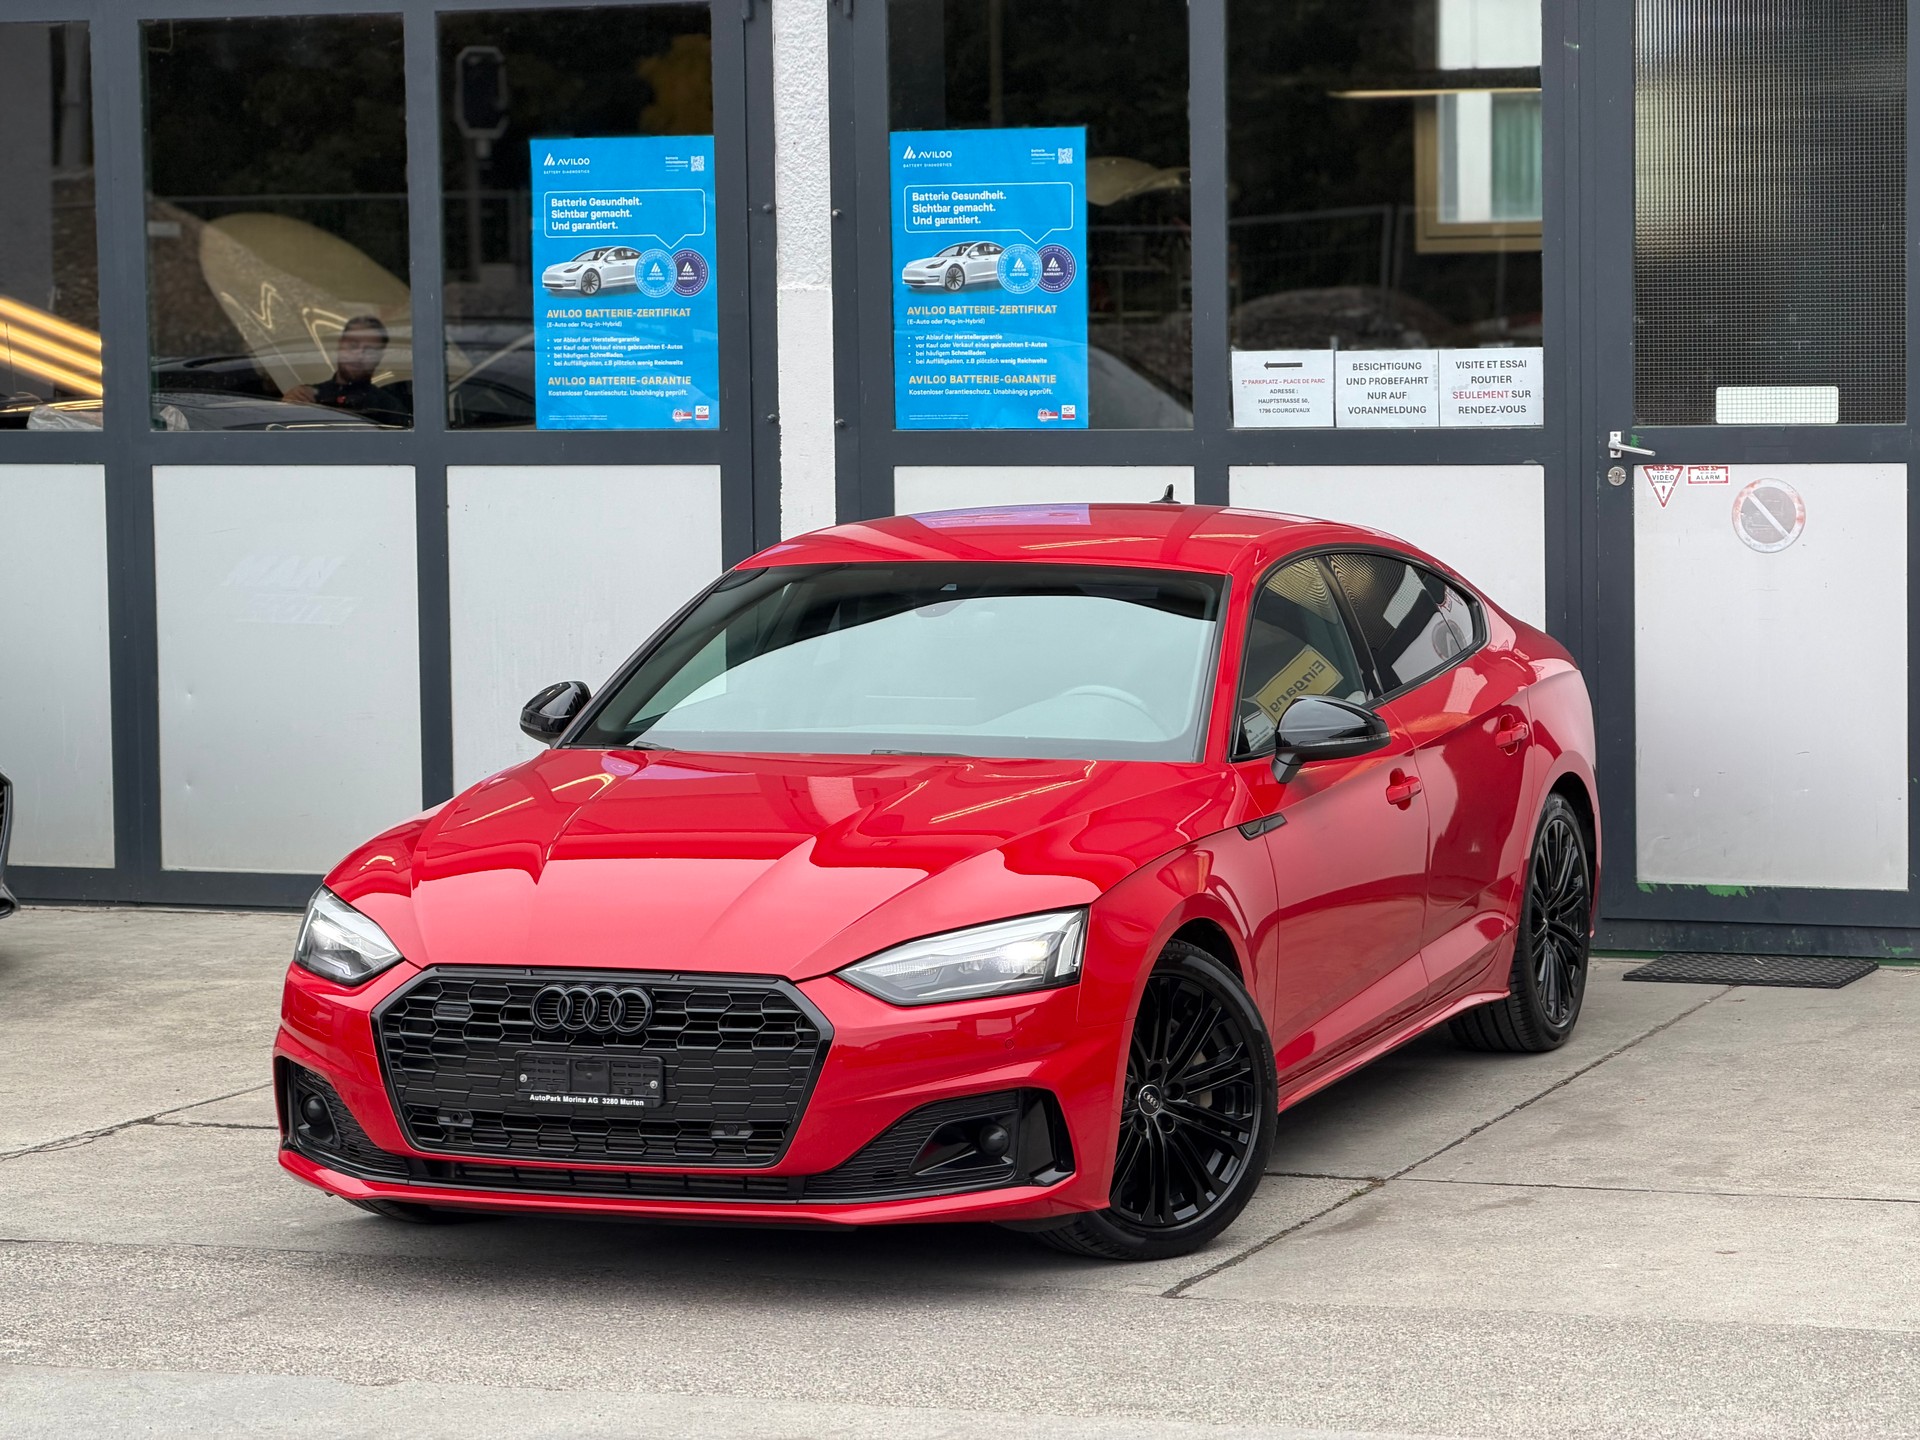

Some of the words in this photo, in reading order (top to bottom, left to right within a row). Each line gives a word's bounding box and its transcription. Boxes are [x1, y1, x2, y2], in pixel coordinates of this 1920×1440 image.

[557, 158, 590, 166] AVILOO
[912, 191, 949, 201] Batterie
[952, 190, 1006, 200] Gesundheit.
[551, 197, 587, 207] Batterie
[589, 196, 642, 207] Gesundheit.
[912, 204, 951, 213] Sichtbar
[953, 202, 996, 214] gemacht.
[551, 210, 588, 218] Sichtbar
[590, 209, 632, 220] gemacht.
[552, 221, 570, 230] Und
[572, 220, 618, 232] garantiert.
[912, 216, 932, 225] Und
[935, 215, 981, 227] garantiert.
[547, 309, 582, 318] AVILOO
[585, 308, 691, 318] BATTERIE-ZERTIFIKAT
[907, 306, 946, 315] AVILOO
[949, 305, 1057, 314] BATTERIE-ZERTIFIKAT
[944, 318, 985, 326] Plug-in-Hybrid)
[1352, 362, 1422, 371] BESICHTIGUNG
[1456, 360, 1485, 370] VISITE
[1487, 360, 1498, 369] ET
[1500, 360, 1527, 369] ESSAI
[548, 377, 586, 386] AVILOO
[589, 376, 691, 385] BATTERIE-GARANTIE
[909, 375, 947, 384] AVILOO
[950, 374, 1057, 384] BATTERIE-GARANTIE
[1346, 376, 1366, 386] UND
[1368, 376, 1429, 386] PROBEFAHRT
[1471, 375, 1512, 384] ROUTIER
[1367, 391, 1387, 400] NUR
[1389, 391, 1407, 400] AUF
[1452, 390, 1509, 399] SEULEMENT
[1511, 390, 1531, 399] SUR
[1348, 405, 1427, 415] VORANMELDUNG
[1458, 405, 1527, 415] RENDEZ-VOUS
[530, 1094, 561, 1103] AutoPark
